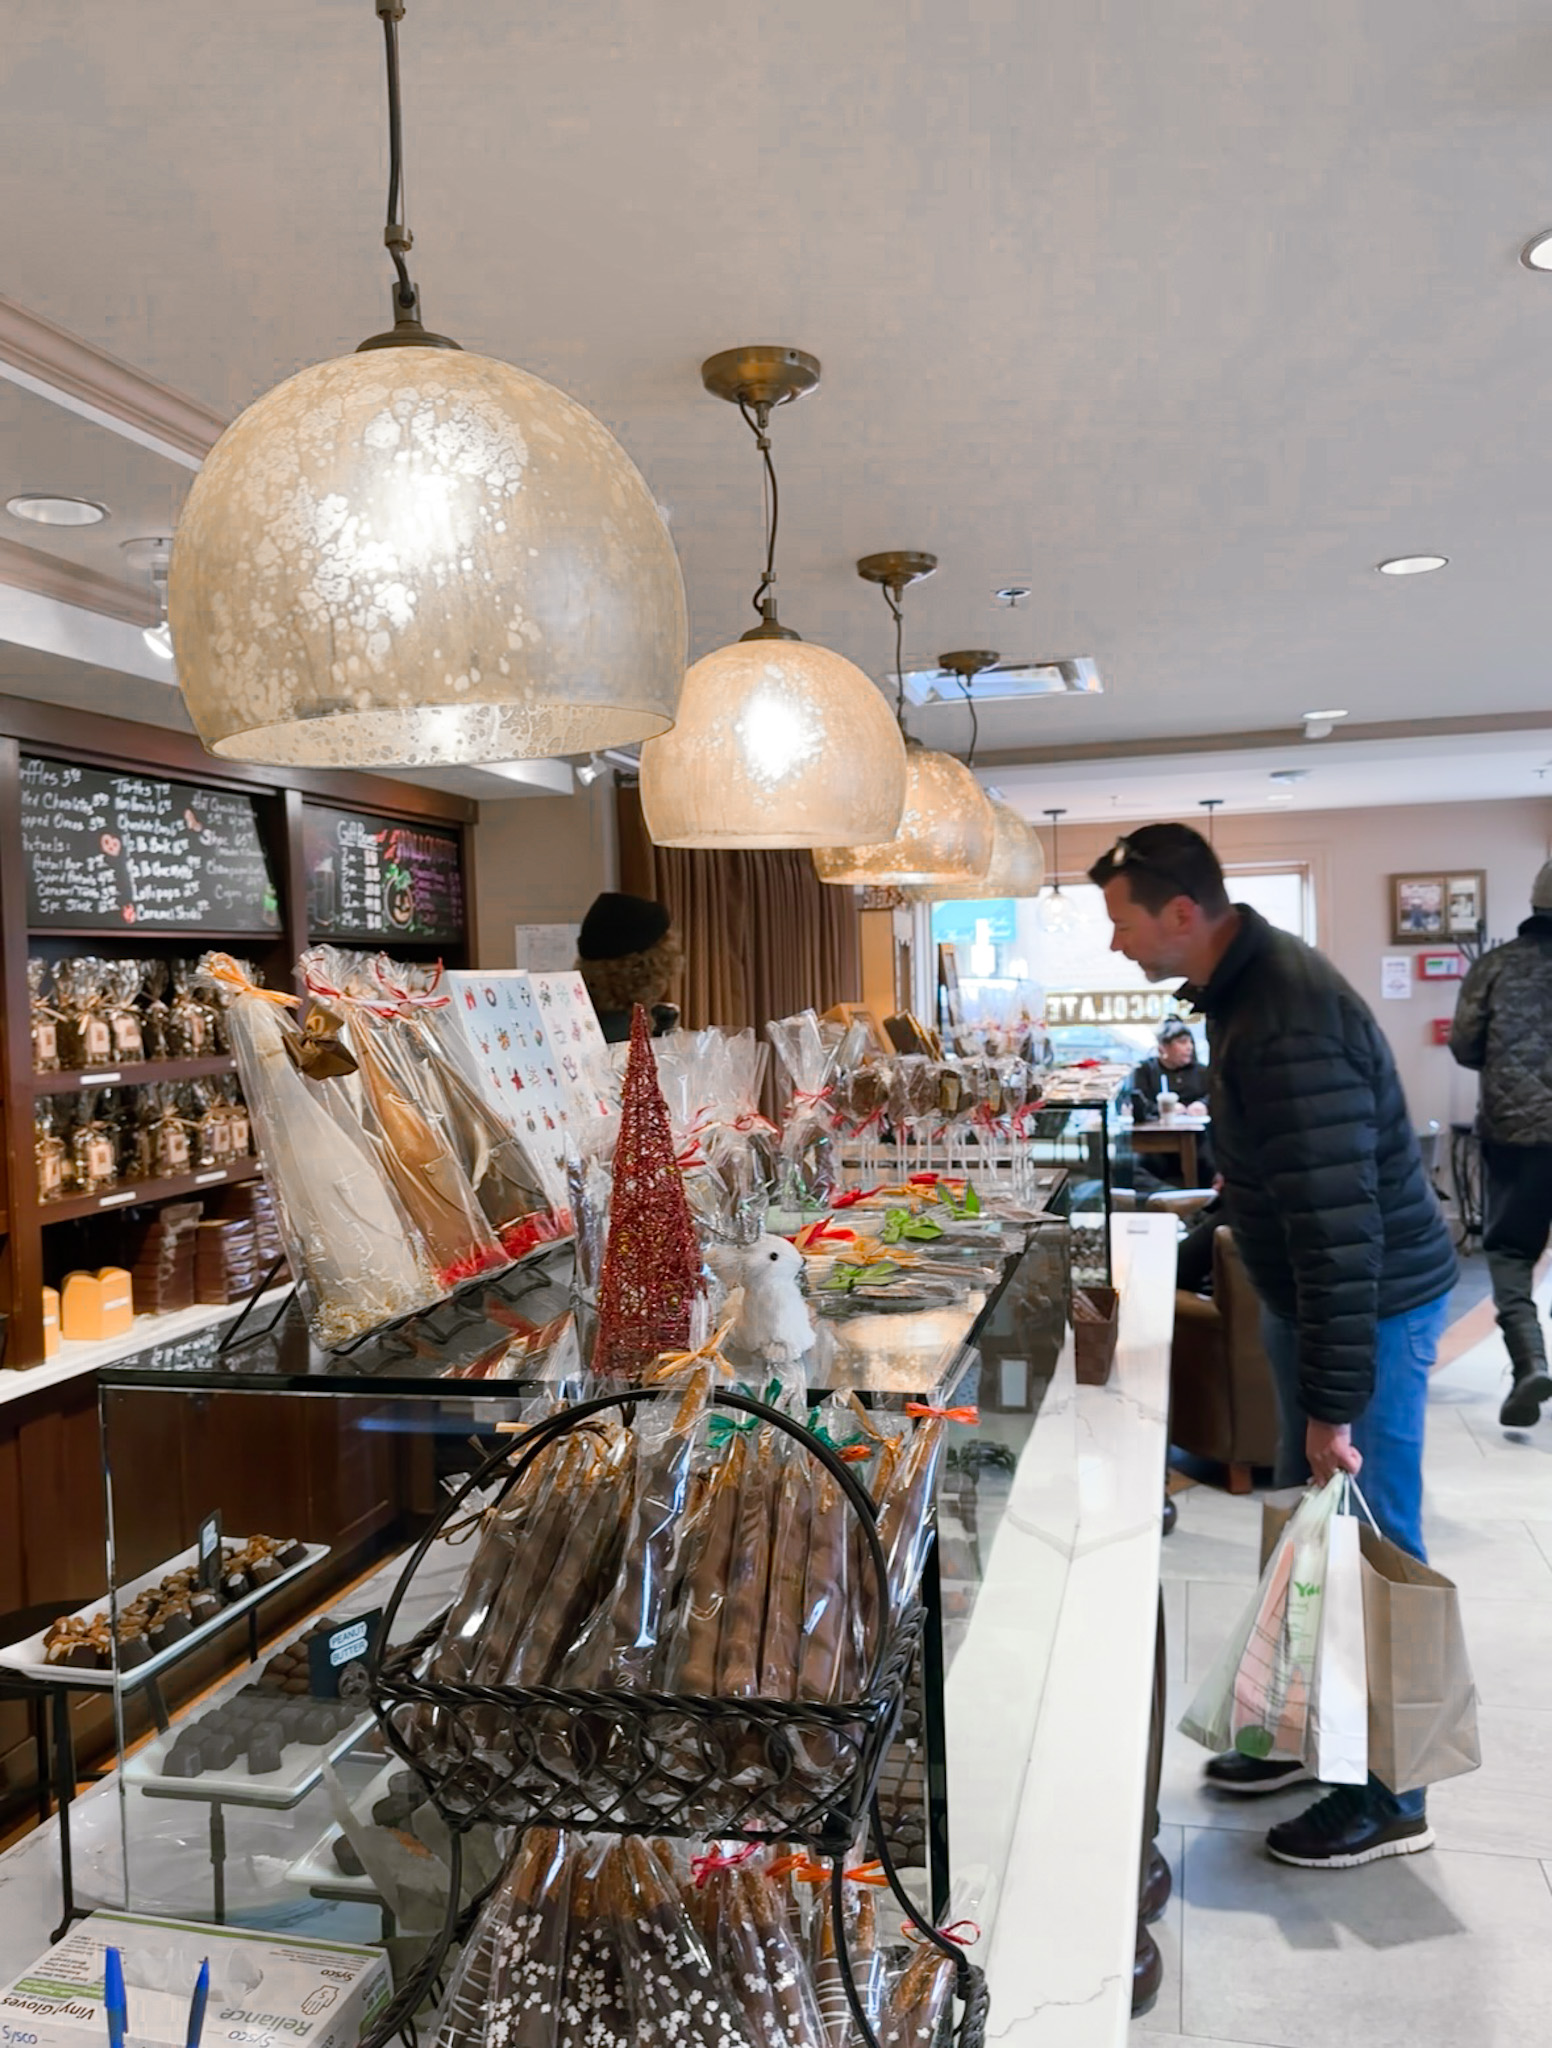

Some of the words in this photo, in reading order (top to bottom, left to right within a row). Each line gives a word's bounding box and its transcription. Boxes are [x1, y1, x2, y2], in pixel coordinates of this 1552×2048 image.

[331, 1623, 366, 1647] PEANUT
[332, 1640, 366, 1664] BUTTER
[320, 1968, 356, 1982] Sysco
[0, 1997, 54, 2016] Gloves
[52, 2001, 96, 2021] Vinyl
[219, 2008, 315, 2037] Reliance
[2, 2025, 38, 2045] Sysco
[227, 2030, 276, 2048] Sysco
